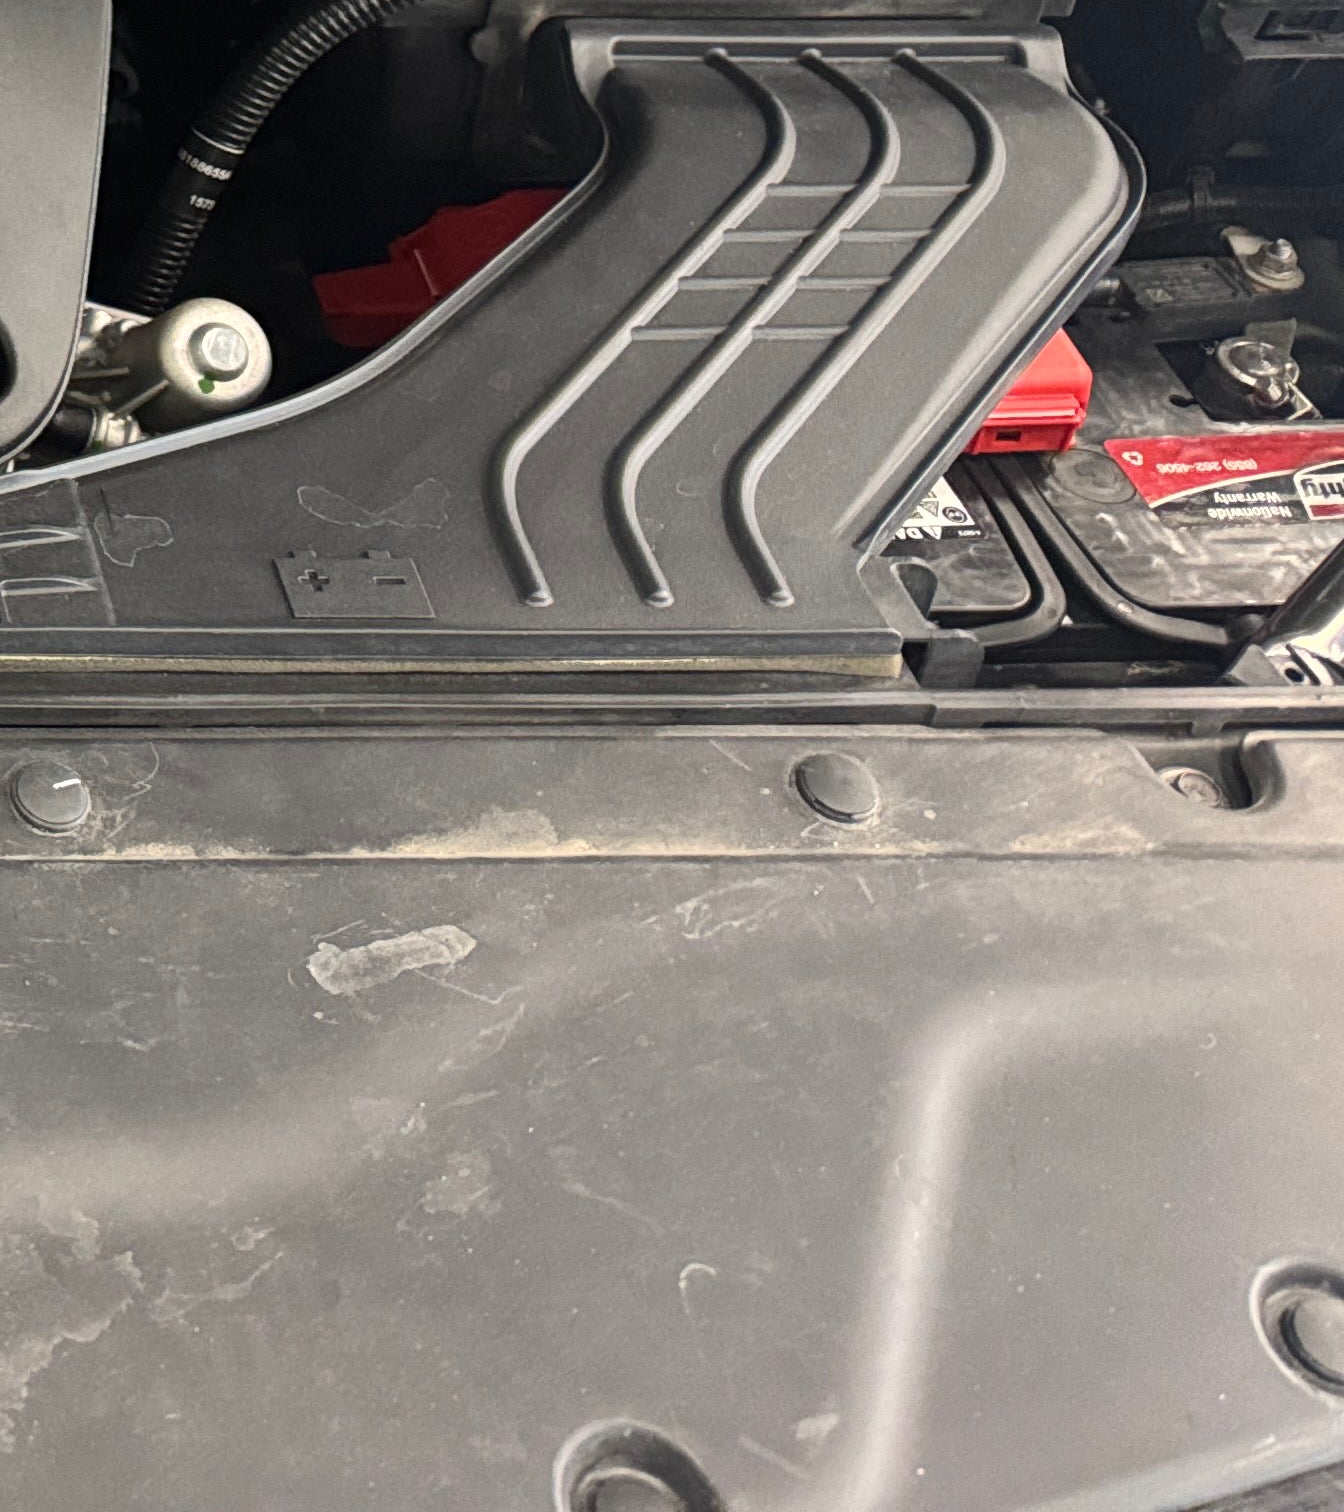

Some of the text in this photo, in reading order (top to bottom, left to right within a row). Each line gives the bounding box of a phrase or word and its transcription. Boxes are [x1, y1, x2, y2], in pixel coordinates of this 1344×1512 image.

[1300, 477, 1344, 500] hty
[1213, 491, 1282, 505] Warranty
[1207, 505, 1292, 520] Nationwide
